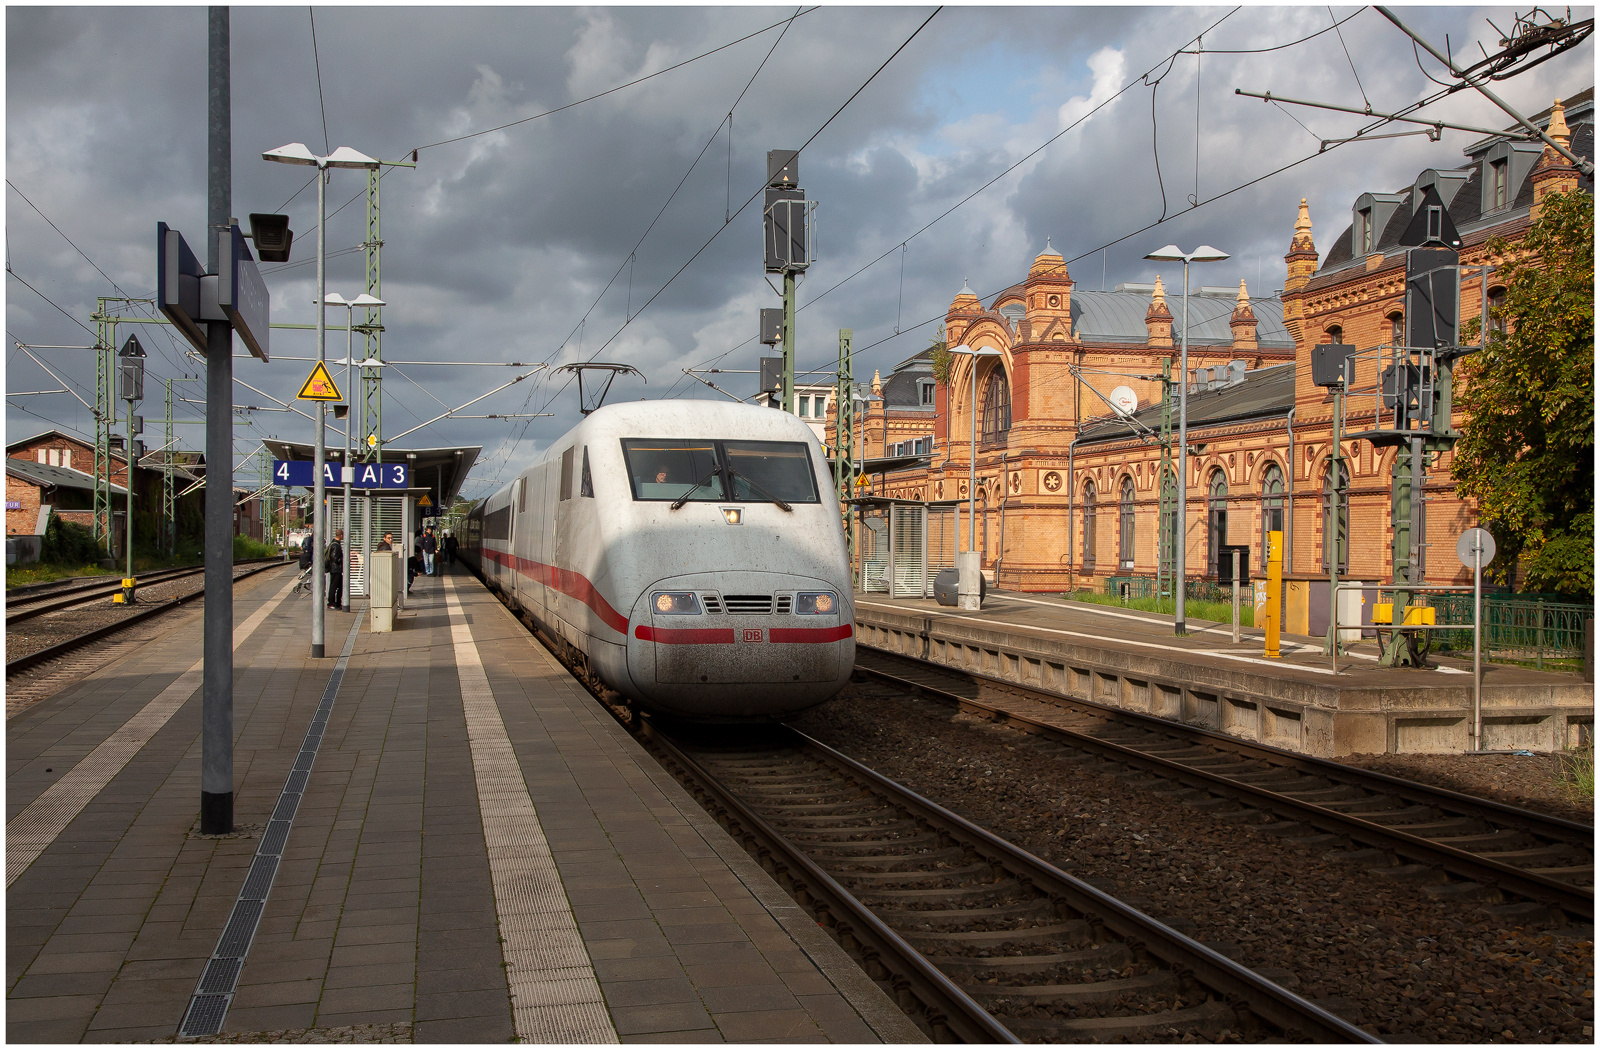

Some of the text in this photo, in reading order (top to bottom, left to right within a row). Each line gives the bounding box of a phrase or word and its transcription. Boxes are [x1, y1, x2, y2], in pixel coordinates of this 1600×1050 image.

[276, 462, 335, 482] 4 A
[361, 464, 405, 484] A 3
[426, 508, 442, 516] B 3
[746, 630, 760, 640] DB
